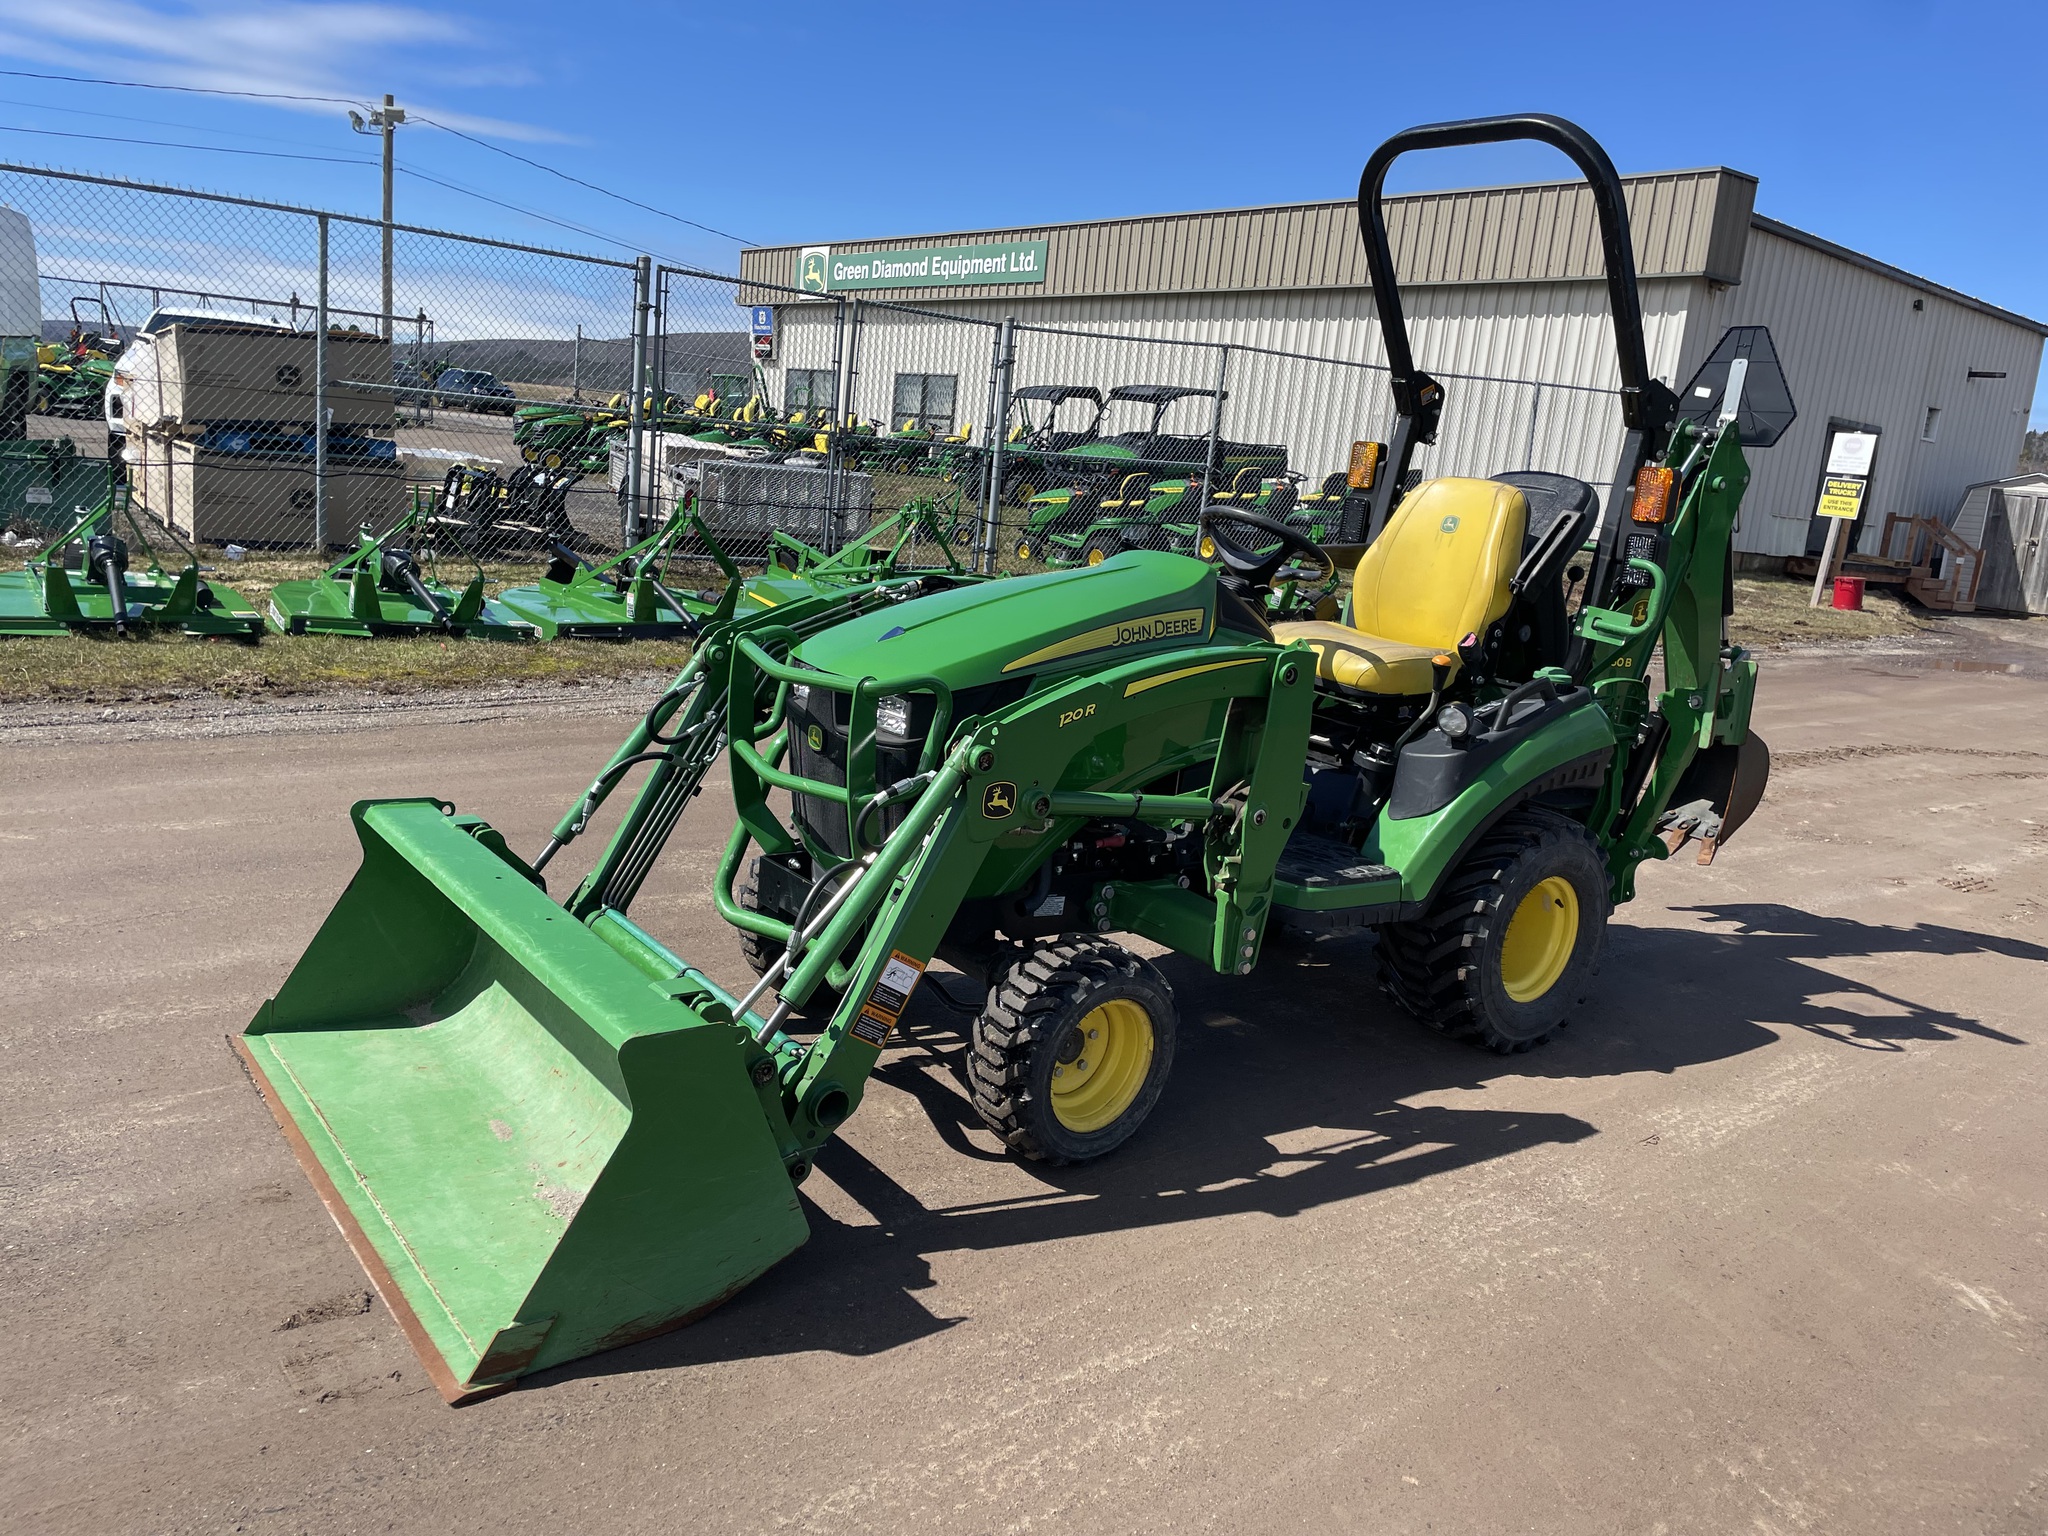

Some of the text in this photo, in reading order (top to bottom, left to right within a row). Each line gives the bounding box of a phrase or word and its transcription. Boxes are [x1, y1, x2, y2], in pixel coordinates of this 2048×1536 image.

[833, 250, 1039, 281] Green Diamond Equipment Ltd.
[1828, 481, 1862, 490] DELIVERY
[1829, 488, 1857, 496] TRUCKS
[1823, 505, 1854, 513] ENTRANCE
[1112, 618, 1198, 645] JOHN DEERE
[900, 955, 921, 969] WARNING
[870, 1010, 893, 1024] WARNING
